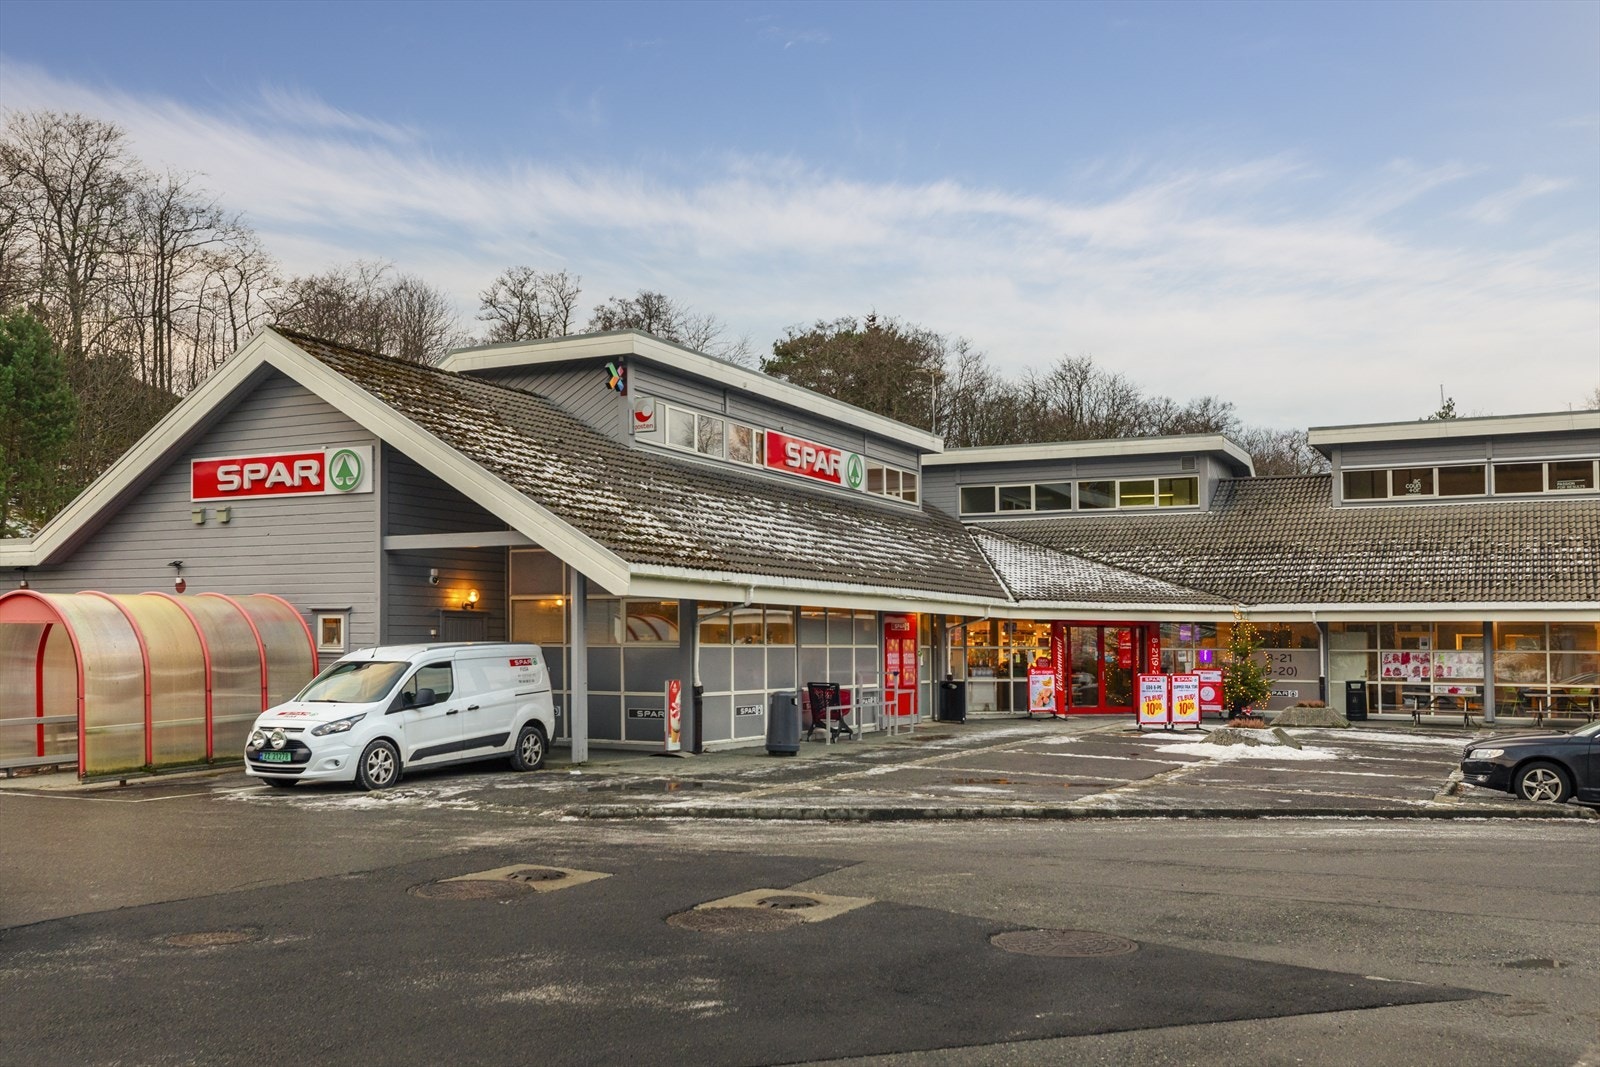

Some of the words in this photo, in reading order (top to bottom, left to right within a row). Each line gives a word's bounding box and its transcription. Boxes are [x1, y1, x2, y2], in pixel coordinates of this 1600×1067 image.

[635, 423, 653, 431] posten
[785, 442, 841, 478] SPAR
[217, 459, 321, 491] SPAR
[1054, 636, 1063, 691] Velkommen!
[1144, 694, 1163, 702] TILBUD!
[1177, 693, 1196, 702] TILBUD!
[637, 710, 665, 718] SPAR
